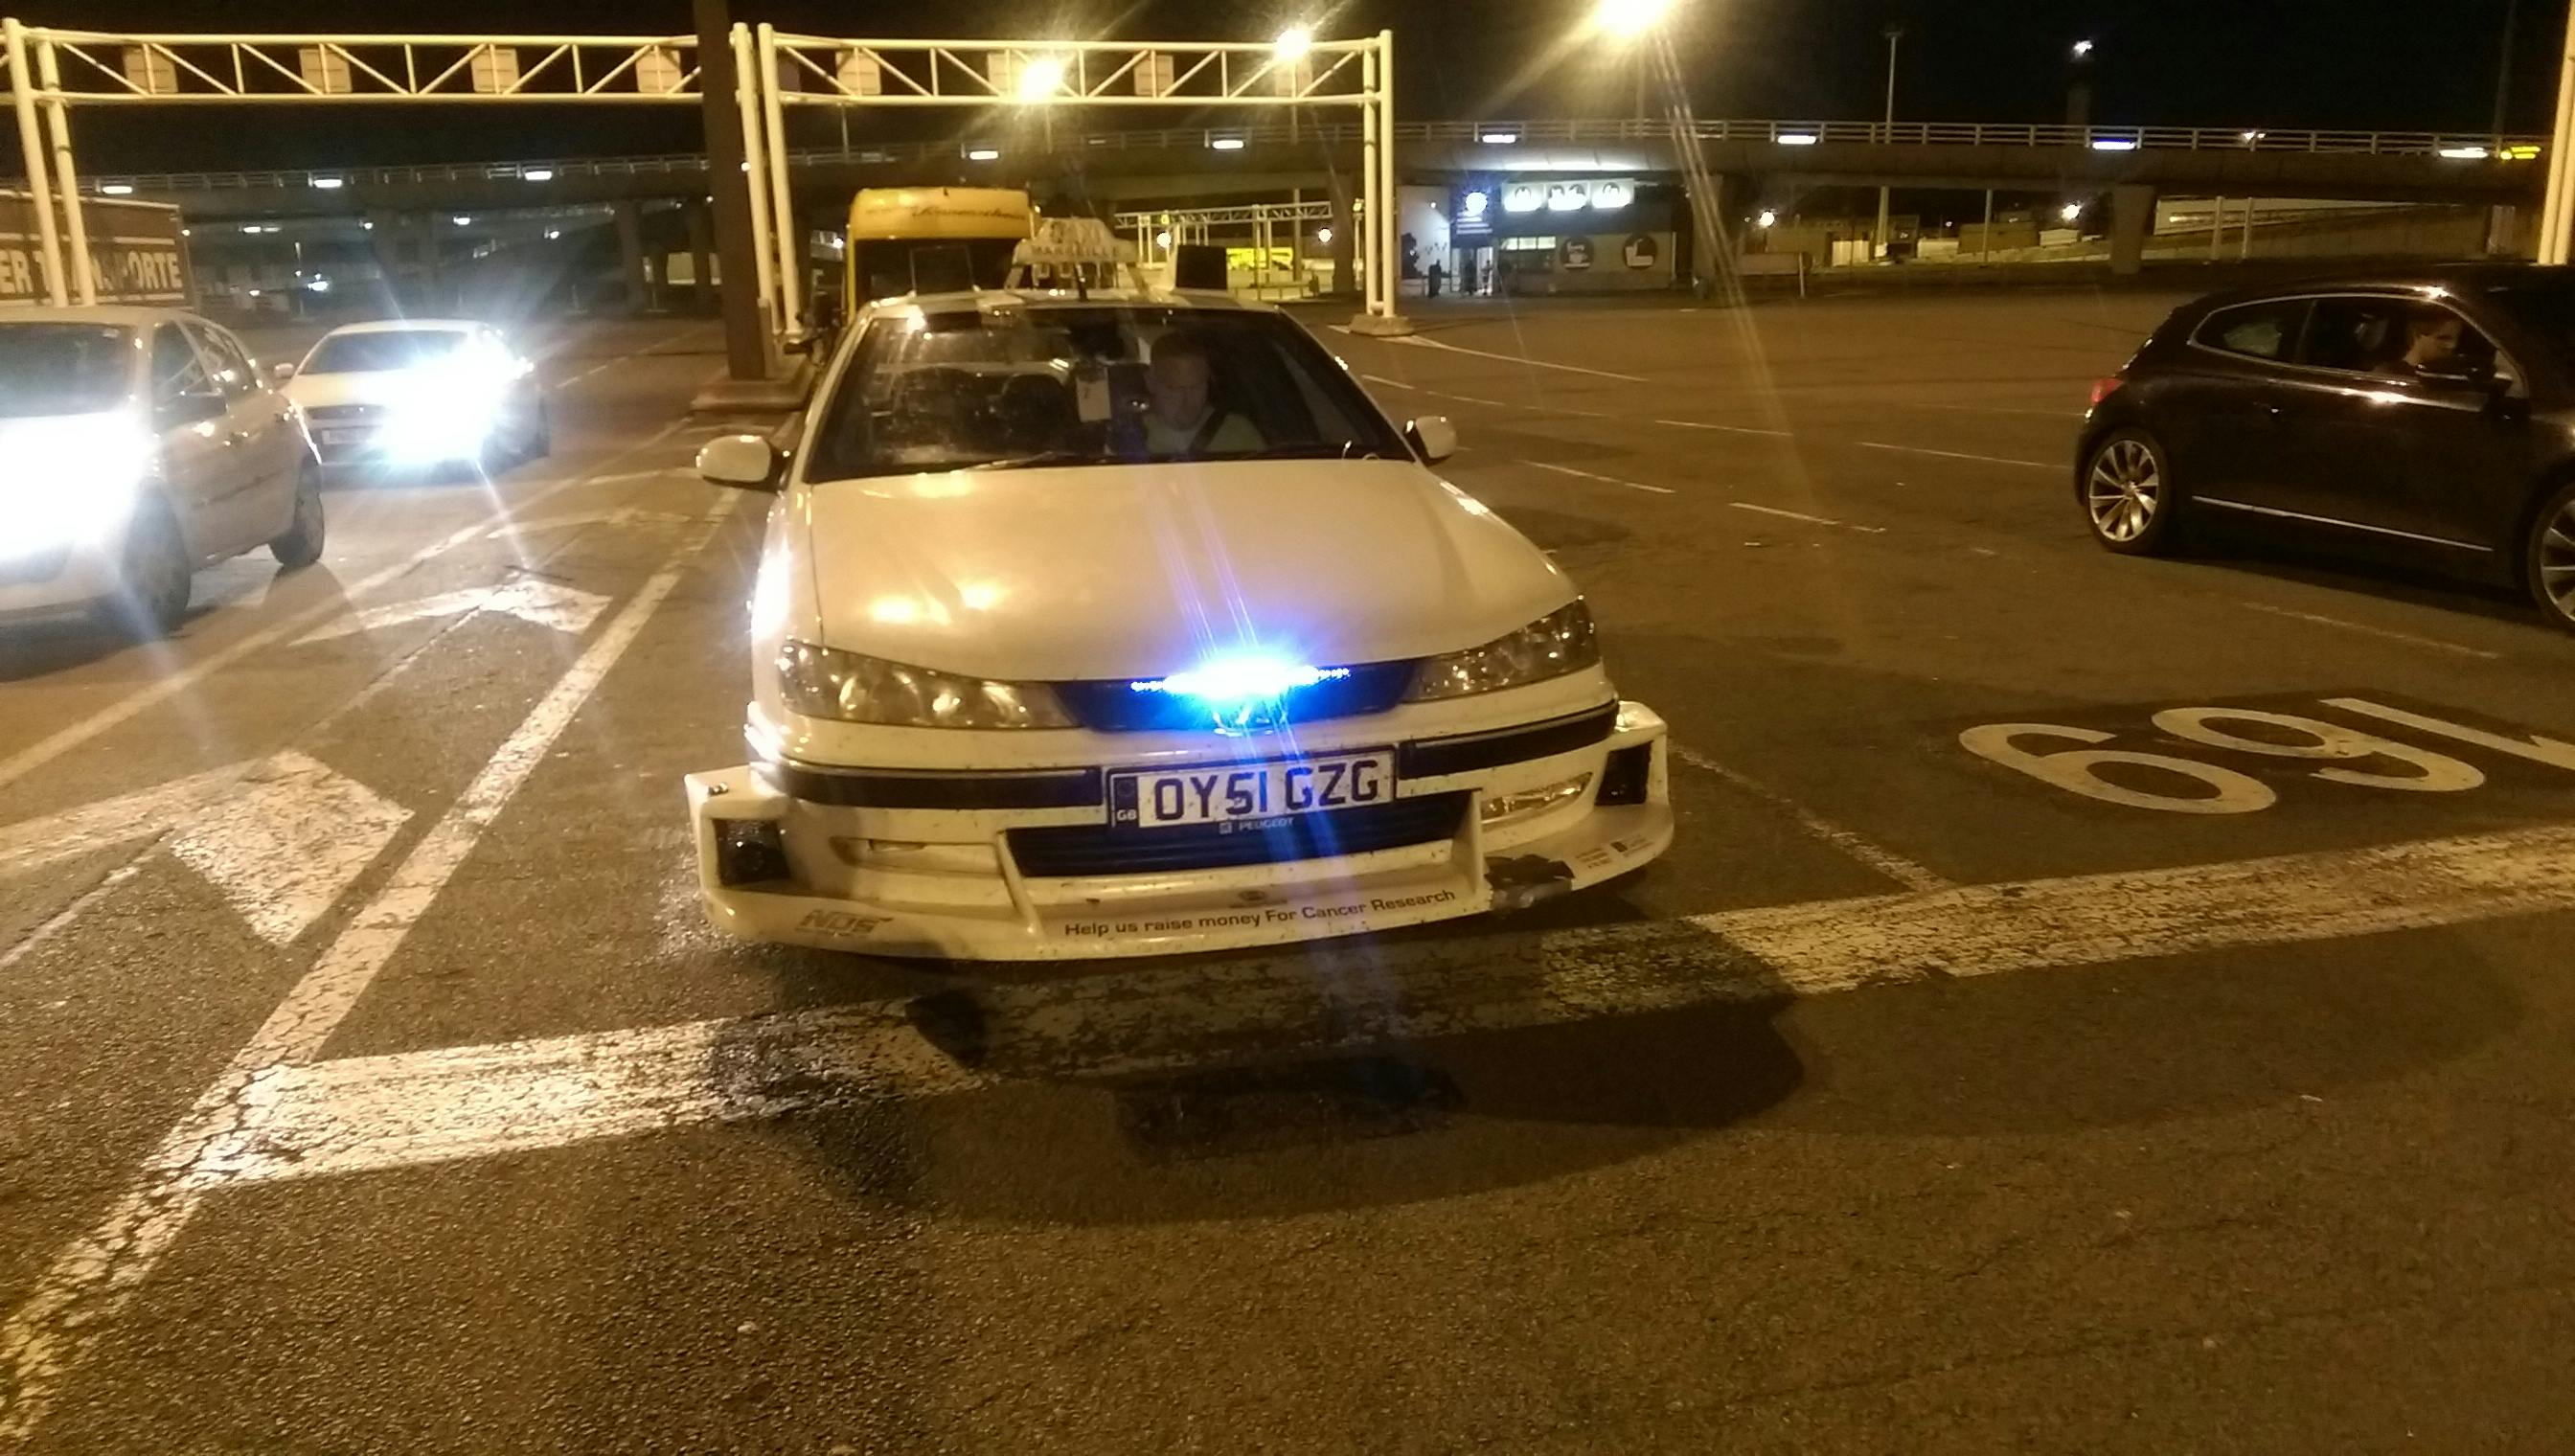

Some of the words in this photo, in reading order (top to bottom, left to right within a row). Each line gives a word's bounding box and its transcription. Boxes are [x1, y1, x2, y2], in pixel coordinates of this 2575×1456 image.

[33, 250, 183, 292] TNSPORTE
[1153, 771, 1267, 820] OY51
[1285, 760, 1379, 810] GZG
[1116, 809, 1137, 822] GB
[1239, 817, 1295, 831] PEUGEOT
[799, 908, 883, 935] NOS
[1064, 921, 1108, 938] Help
[1115, 924, 1138, 934] us
[1144, 919, 1193, 932] raise
[1198, 913, 1261, 927] money
[1266, 910, 1297, 922] For
[1302, 903, 1367, 920] Cancer
[1371, 889, 1455, 912] Research
